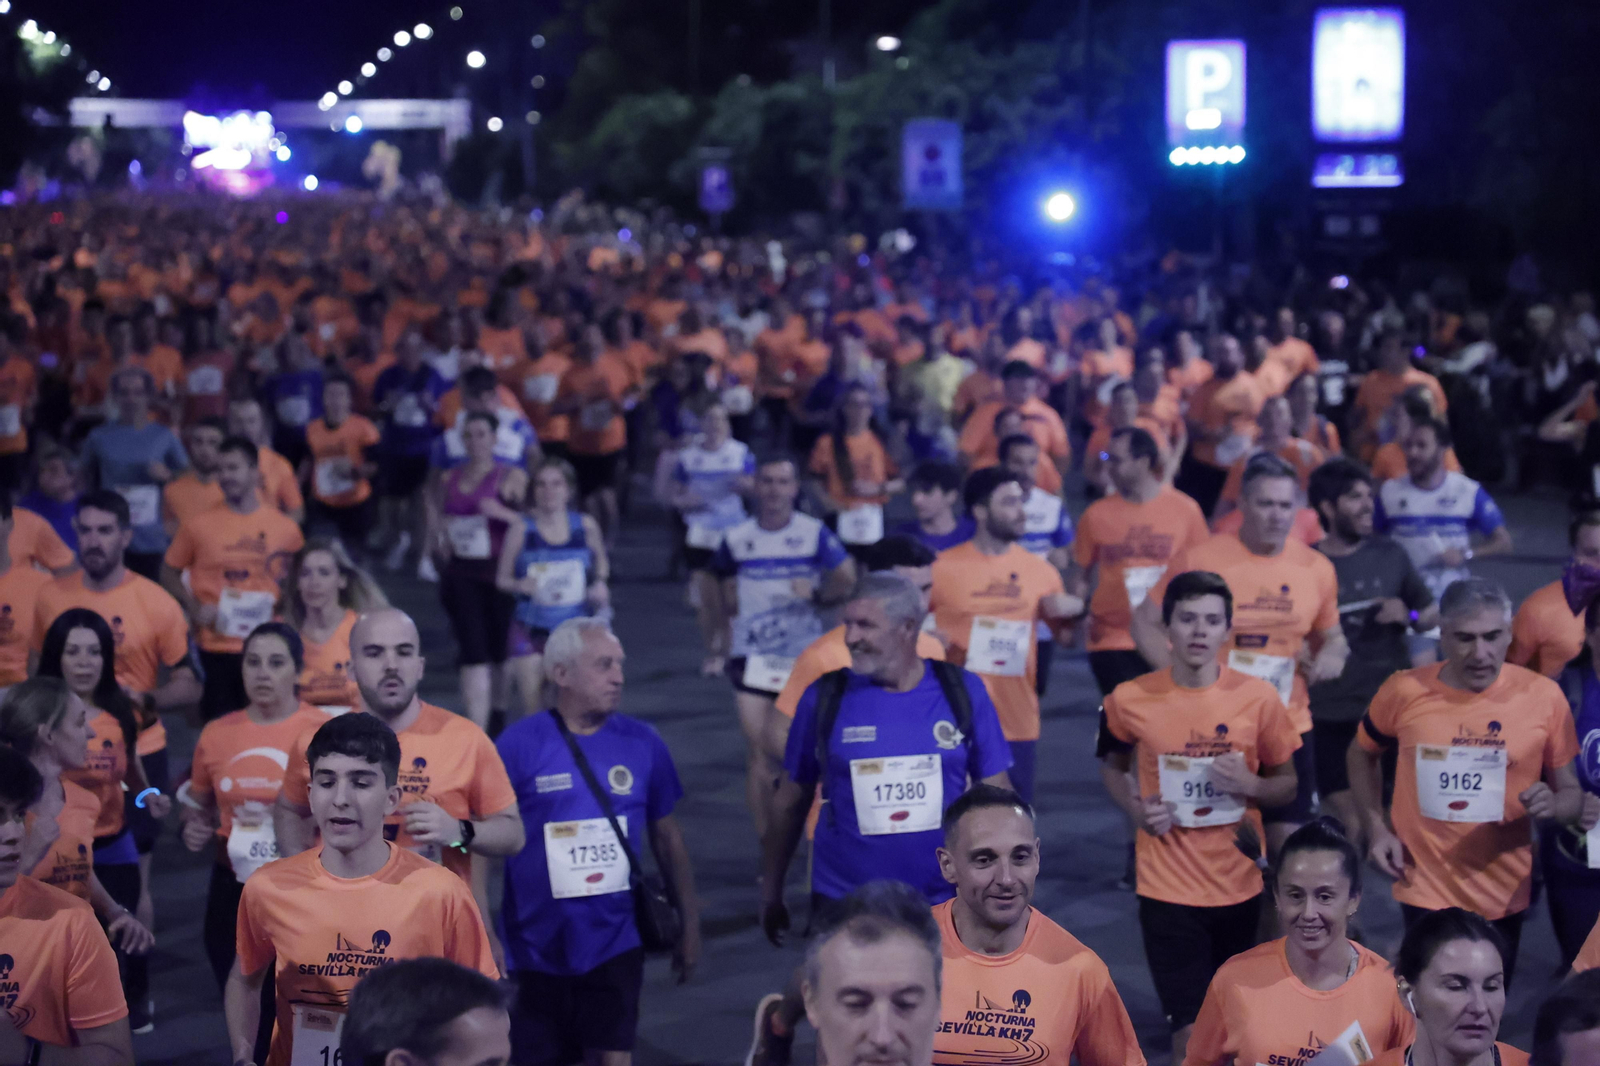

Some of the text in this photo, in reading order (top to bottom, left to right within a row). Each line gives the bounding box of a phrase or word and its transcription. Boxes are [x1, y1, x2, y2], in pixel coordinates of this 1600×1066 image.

[1183, 781, 1224, 798] 916
[1439, 771, 1483, 791] 9162
[873, 780, 926, 802] 17380
[568, 843, 619, 864] 17385
[298, 963, 355, 977] SEVILLA
[965, 1010, 1036, 1028] NOCTURNA
